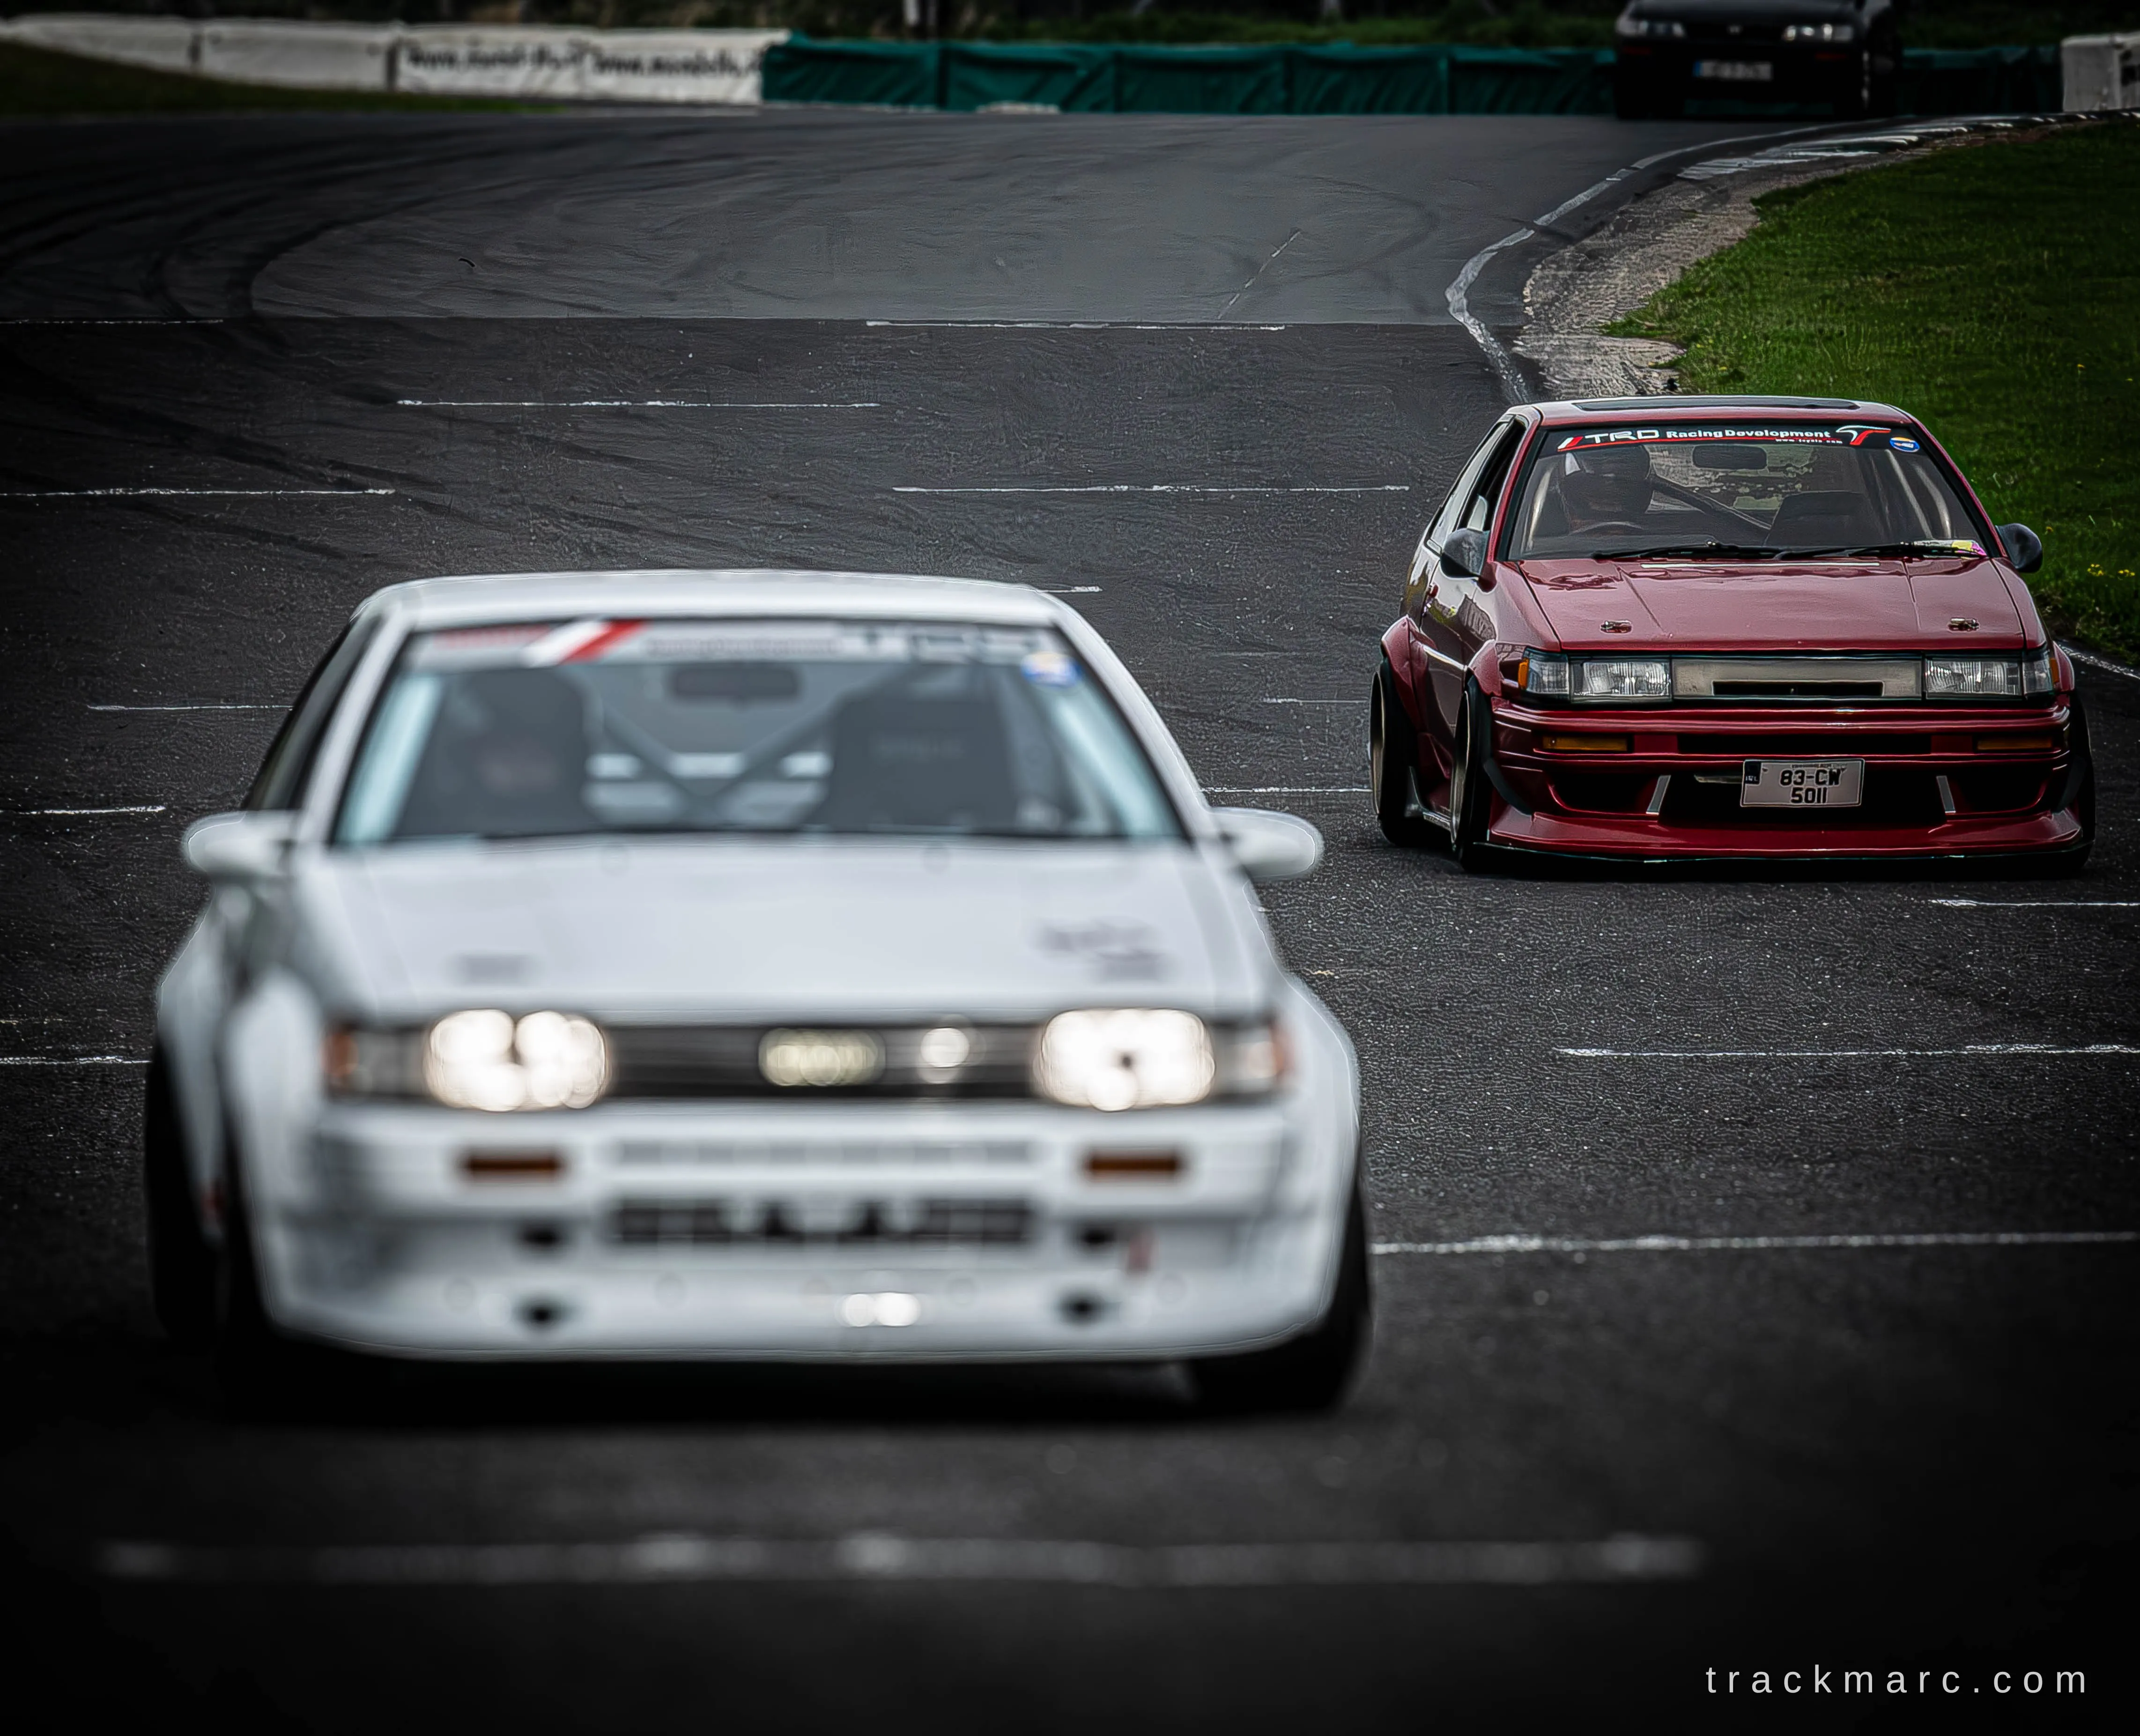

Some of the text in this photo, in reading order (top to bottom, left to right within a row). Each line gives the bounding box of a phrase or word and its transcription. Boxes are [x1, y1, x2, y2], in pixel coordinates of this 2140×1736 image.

[1585, 430, 1659, 443] TRD
[1780, 770, 1841, 786] 83-CW
[1791, 787, 1827, 803] 5011
